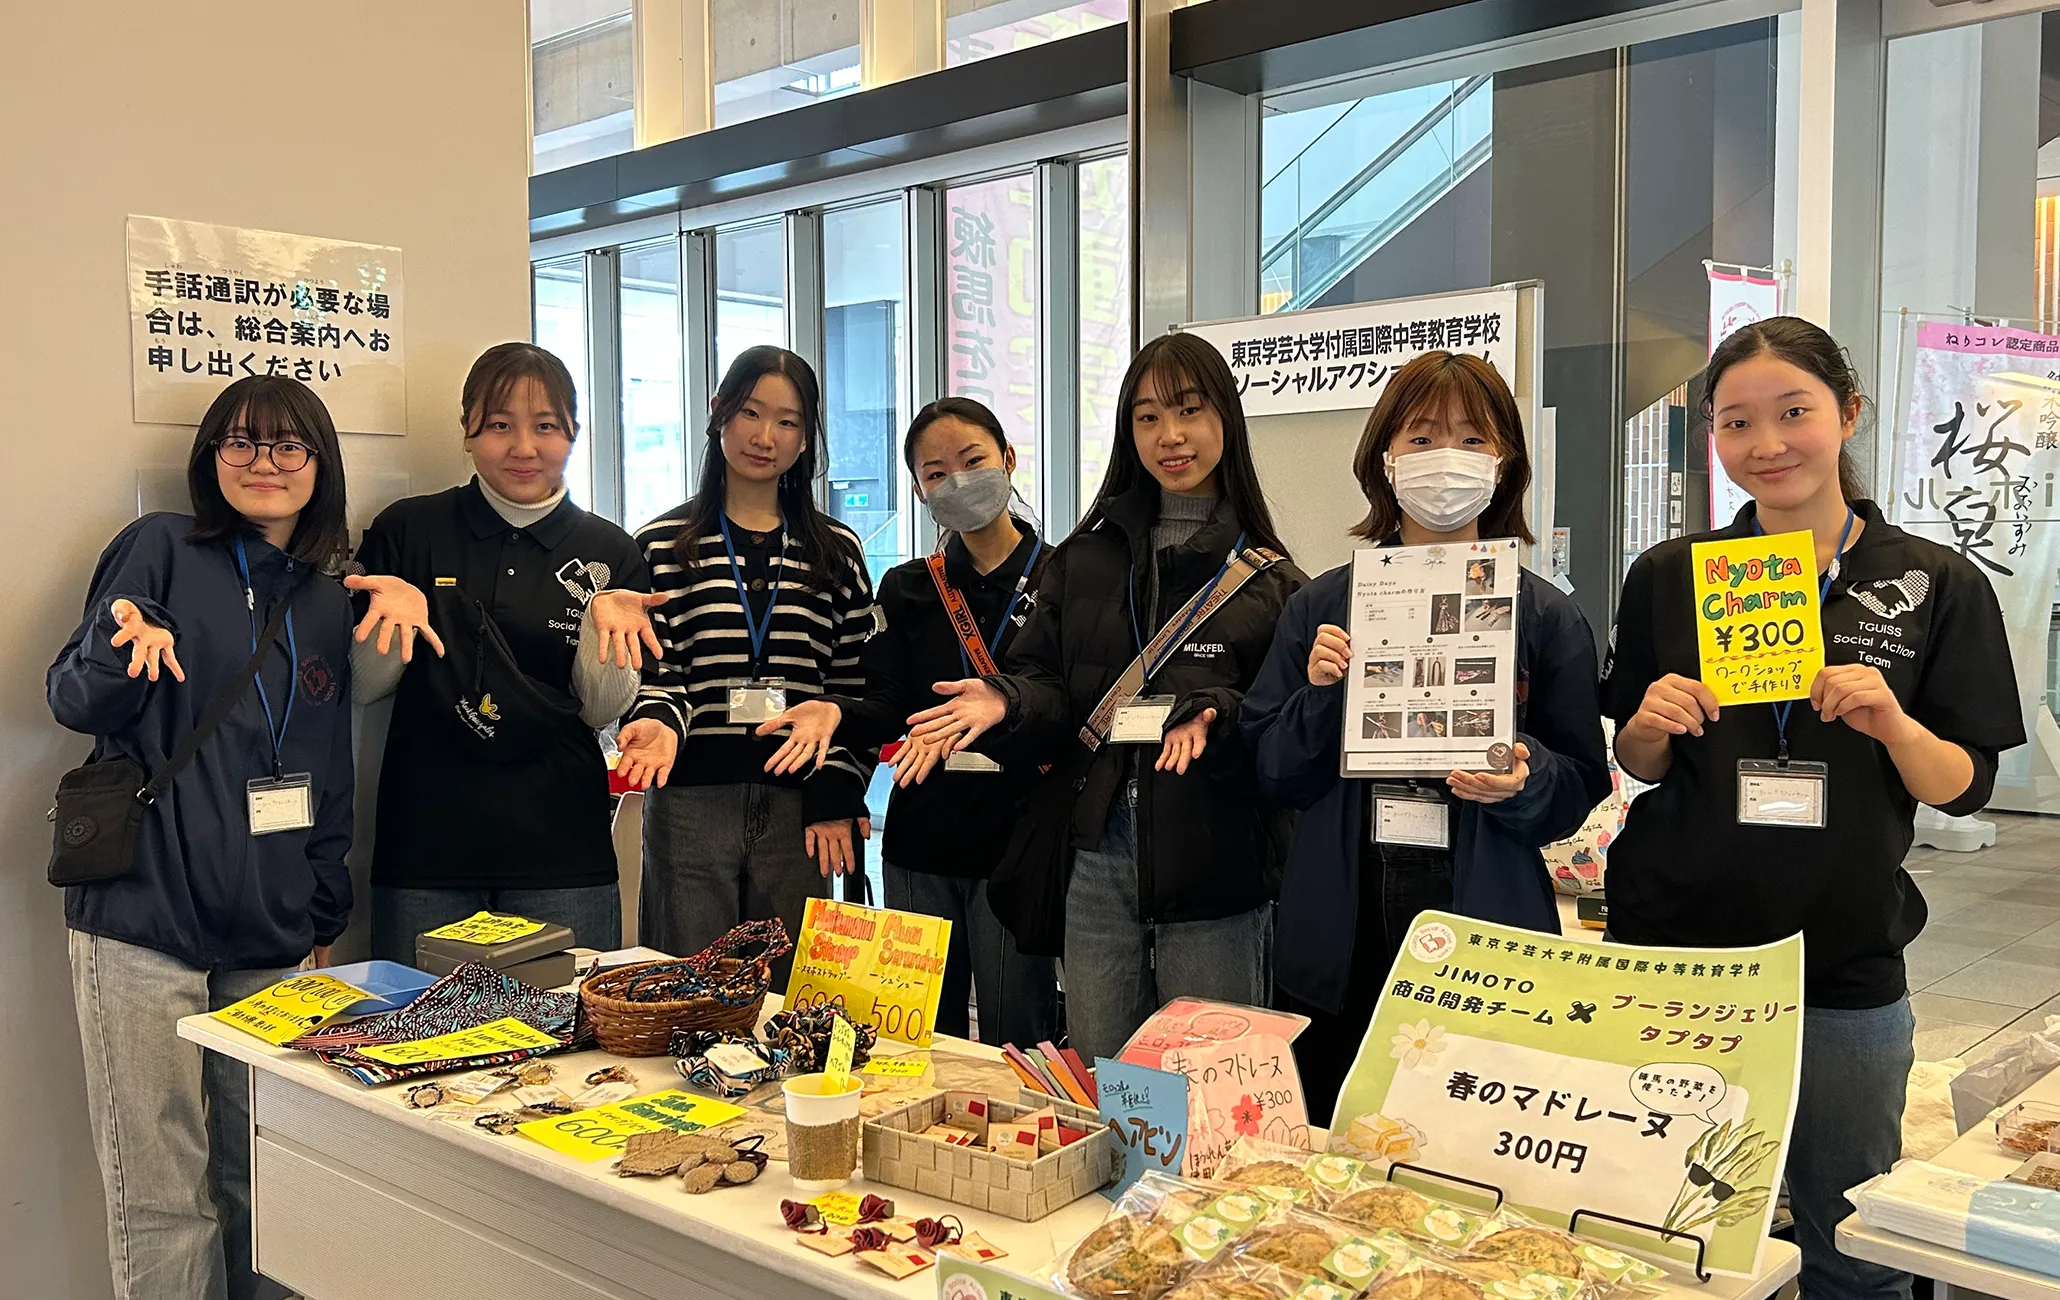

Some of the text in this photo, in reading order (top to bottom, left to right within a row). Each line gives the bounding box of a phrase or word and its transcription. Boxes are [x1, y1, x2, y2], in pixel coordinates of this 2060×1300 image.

[144, 269, 390, 319] 手話通訳が必要な場
[145, 307, 390, 352] 合は、総合案内へお
[1231, 313, 1501, 369] 東京学芸大学付属国際中等教育学校
[1945, 333, 2060, 353] ねりコレ認定商品
[148, 344, 342, 381] 申し出ください
[1233, 360, 1400, 399] ソーシャルアクシ
[1705, 553, 1802, 588] Nyota
[1196, 588, 1228, 620] THEATRE
[1702, 590, 1806, 621] Charm
[548, 619, 576, 631] Social
[953, 603, 977, 642] XGIRL
[1714, 619, 1804, 654] ¥300
[1858, 621, 1902, 638] TGUISS
[1183, 642, 1226, 653] MILKFED.
[1833, 634, 1916, 659] Social Action
[1857, 650, 1892, 670] Team
[1715, 659, 1802, 679] ワークショップ
[1467, 933, 1761, 977] 東京学芸大学附属国際中等教育学校
[1434, 964, 1534, 994] JIMOTO
[1391, 979, 1554, 1026] 商品開発チーム
[1612, 994, 1797, 1023] ブーランジェリー
[1640, 1025, 1743, 1054] タプタプ
[1638, 1072, 1716, 1094] 練馬の野菜を
[1254, 1089, 1293, 1110] ¥300
[1445, 1070, 1673, 1140] 春のマドレーヌ
[1493, 1130, 1588, 1174] 300円
